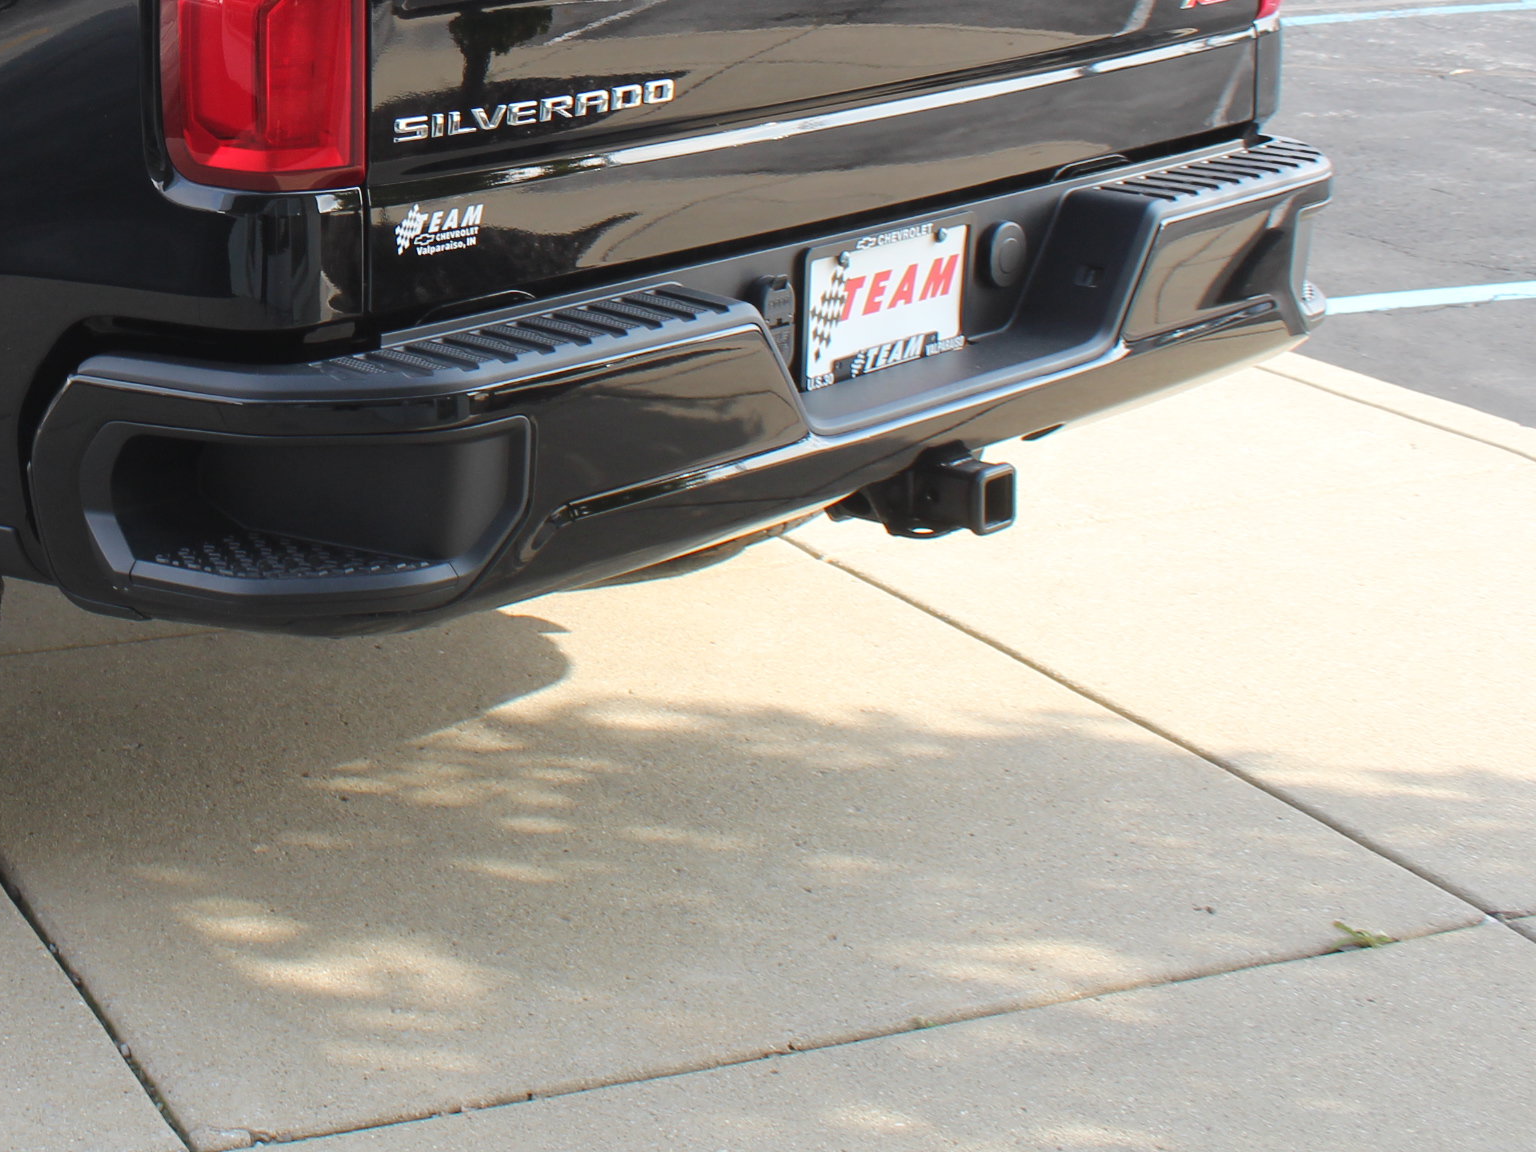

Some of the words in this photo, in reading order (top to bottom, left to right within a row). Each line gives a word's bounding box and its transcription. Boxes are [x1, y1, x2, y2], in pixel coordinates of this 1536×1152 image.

[393, 78, 676, 143] SILVERADO
[415, 204, 484, 236] TEAM
[435, 226, 479, 242] CHEVROLET
[876, 223, 934, 247] CHEVROLET
[416, 240, 466, 256] Valparaiso,
[466, 236, 477, 247] IN
[840, 254, 960, 321] TEAM
[863, 333, 925, 373] TEAM
